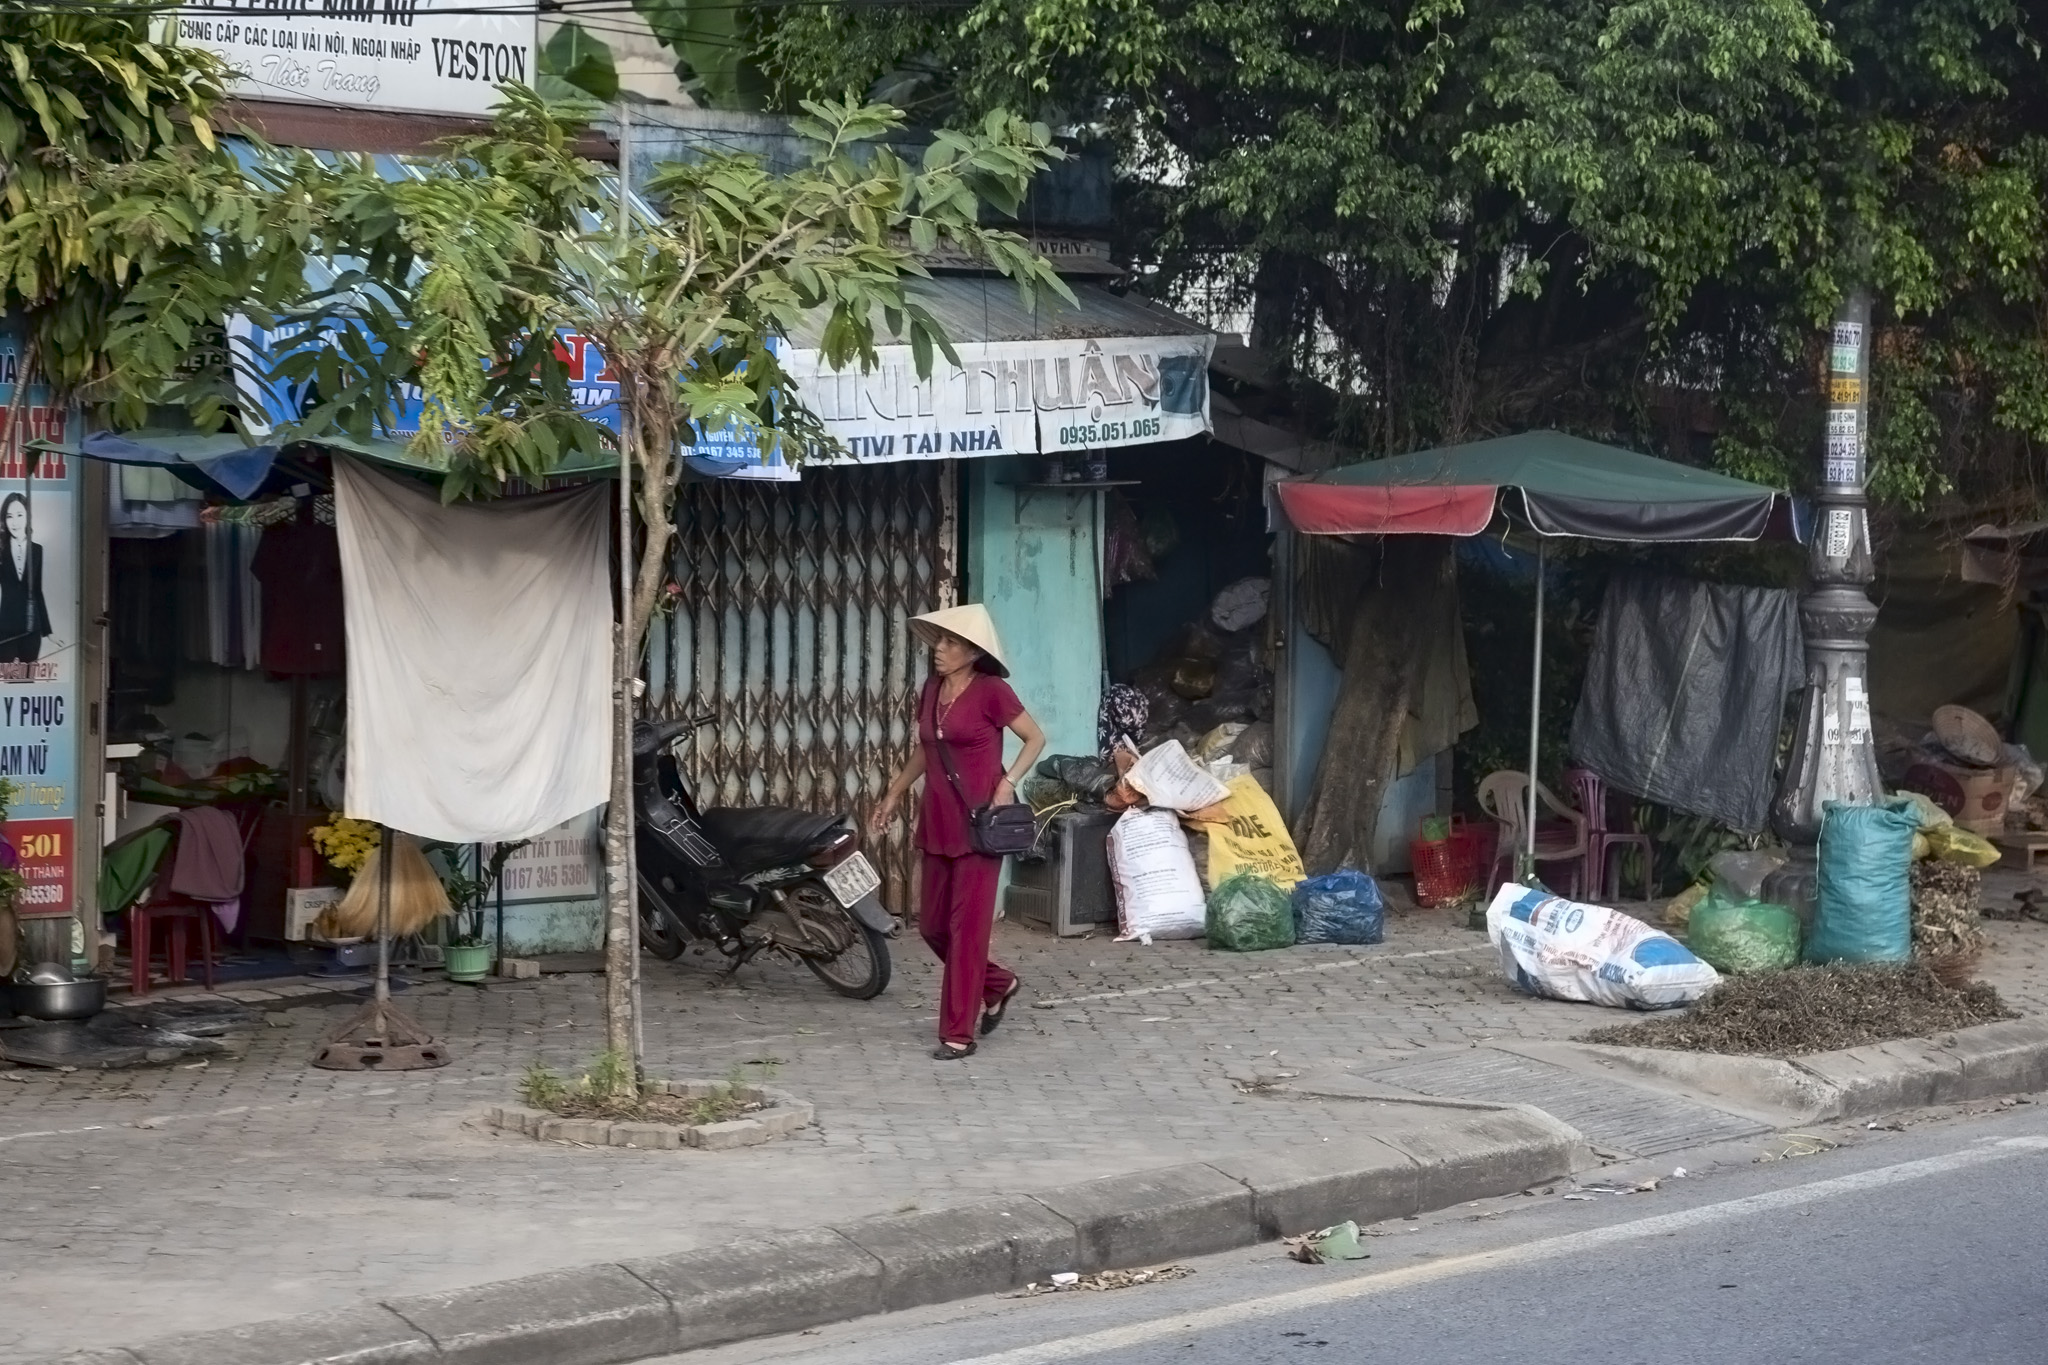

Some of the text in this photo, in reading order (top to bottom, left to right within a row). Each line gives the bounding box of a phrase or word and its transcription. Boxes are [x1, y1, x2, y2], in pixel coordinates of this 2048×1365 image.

[179, 19, 212, 41] CUNG
[216, 19, 240, 44] CẤP
[244, 23, 268, 47] CÁC
[272, 29, 298, 54] LOẠI
[302, 26, 321, 52] VẢI
[352, 36, 387, 62] NGOẠI
[390, 38, 421, 64] NHẬP
[431, 37, 527, 84] VESTON
[317, 59, 381, 102] Trang
[847, 434, 895, 458] TIVI
[950, 425, 1003, 453] NHÀ
[1060, 417, 1160, 445] 0935.051.065
[726, 446, 745, 458] 345
[4, 695, 65, 733] Y PHỤC
[0, 745, 22, 776] AM
[20, 834, 62, 858] 501
[531, 837, 551, 859] TẤT
[555, 836, 592, 857] THÀNH
[504, 867, 532, 891] 0167
[537, 865, 557, 889] 345
[561, 863, 589, 886] 5360
